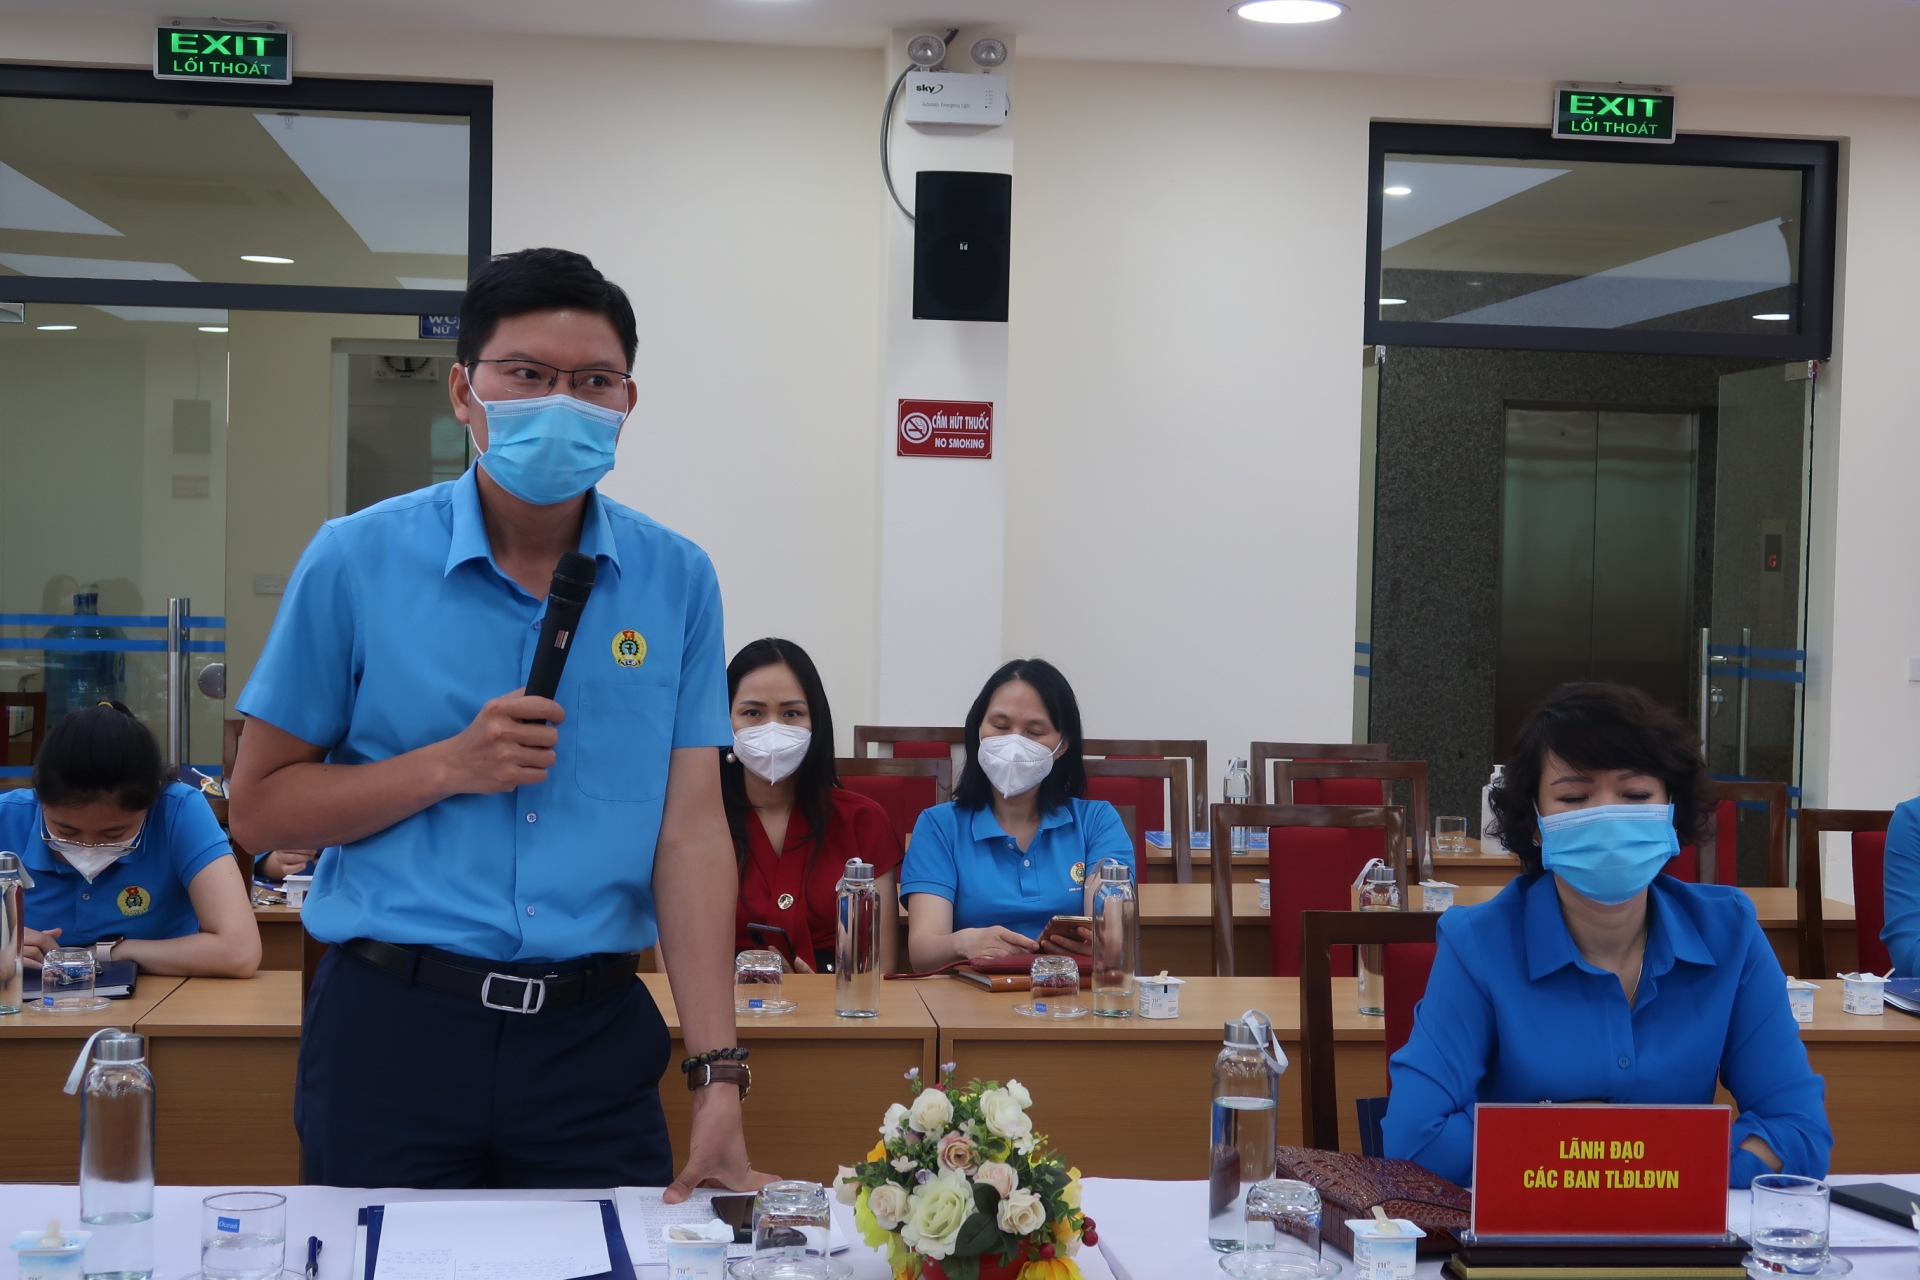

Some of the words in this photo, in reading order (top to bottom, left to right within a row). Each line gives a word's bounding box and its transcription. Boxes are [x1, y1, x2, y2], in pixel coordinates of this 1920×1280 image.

[171, 32, 275, 57] EXIT
[173, 56, 204, 73] LỐI
[209, 61, 272, 76] THOÁT
[916, 83, 936, 94] sky
[1570, 94, 1663, 117] EXIT
[1571, 117, 1598, 132] LỐI
[1603, 121, 1659, 135] THOÁT
[432, 325, 451, 335] NỮ
[932, 410, 948, 429] CẤM
[949, 412, 963, 430] HÚT
[964, 411, 990, 430] THUỐC
[935, 438, 947, 448] NO
[948, 438, 985, 449] SMOKING
[1768, 554, 1778, 568] G
[1559, 1137, 1605, 1159] LÃNH
[1610, 1140, 1645, 1164] ĐẠO
[1523, 1165, 1558, 1189] CÁC
[1563, 1170, 1600, 1189] BAN
[1605, 1170, 1680, 1189] TLĐLĐVN
[218, 1220, 238, 1230] Ocean
[1375, 1269, 1394, 1277] true
